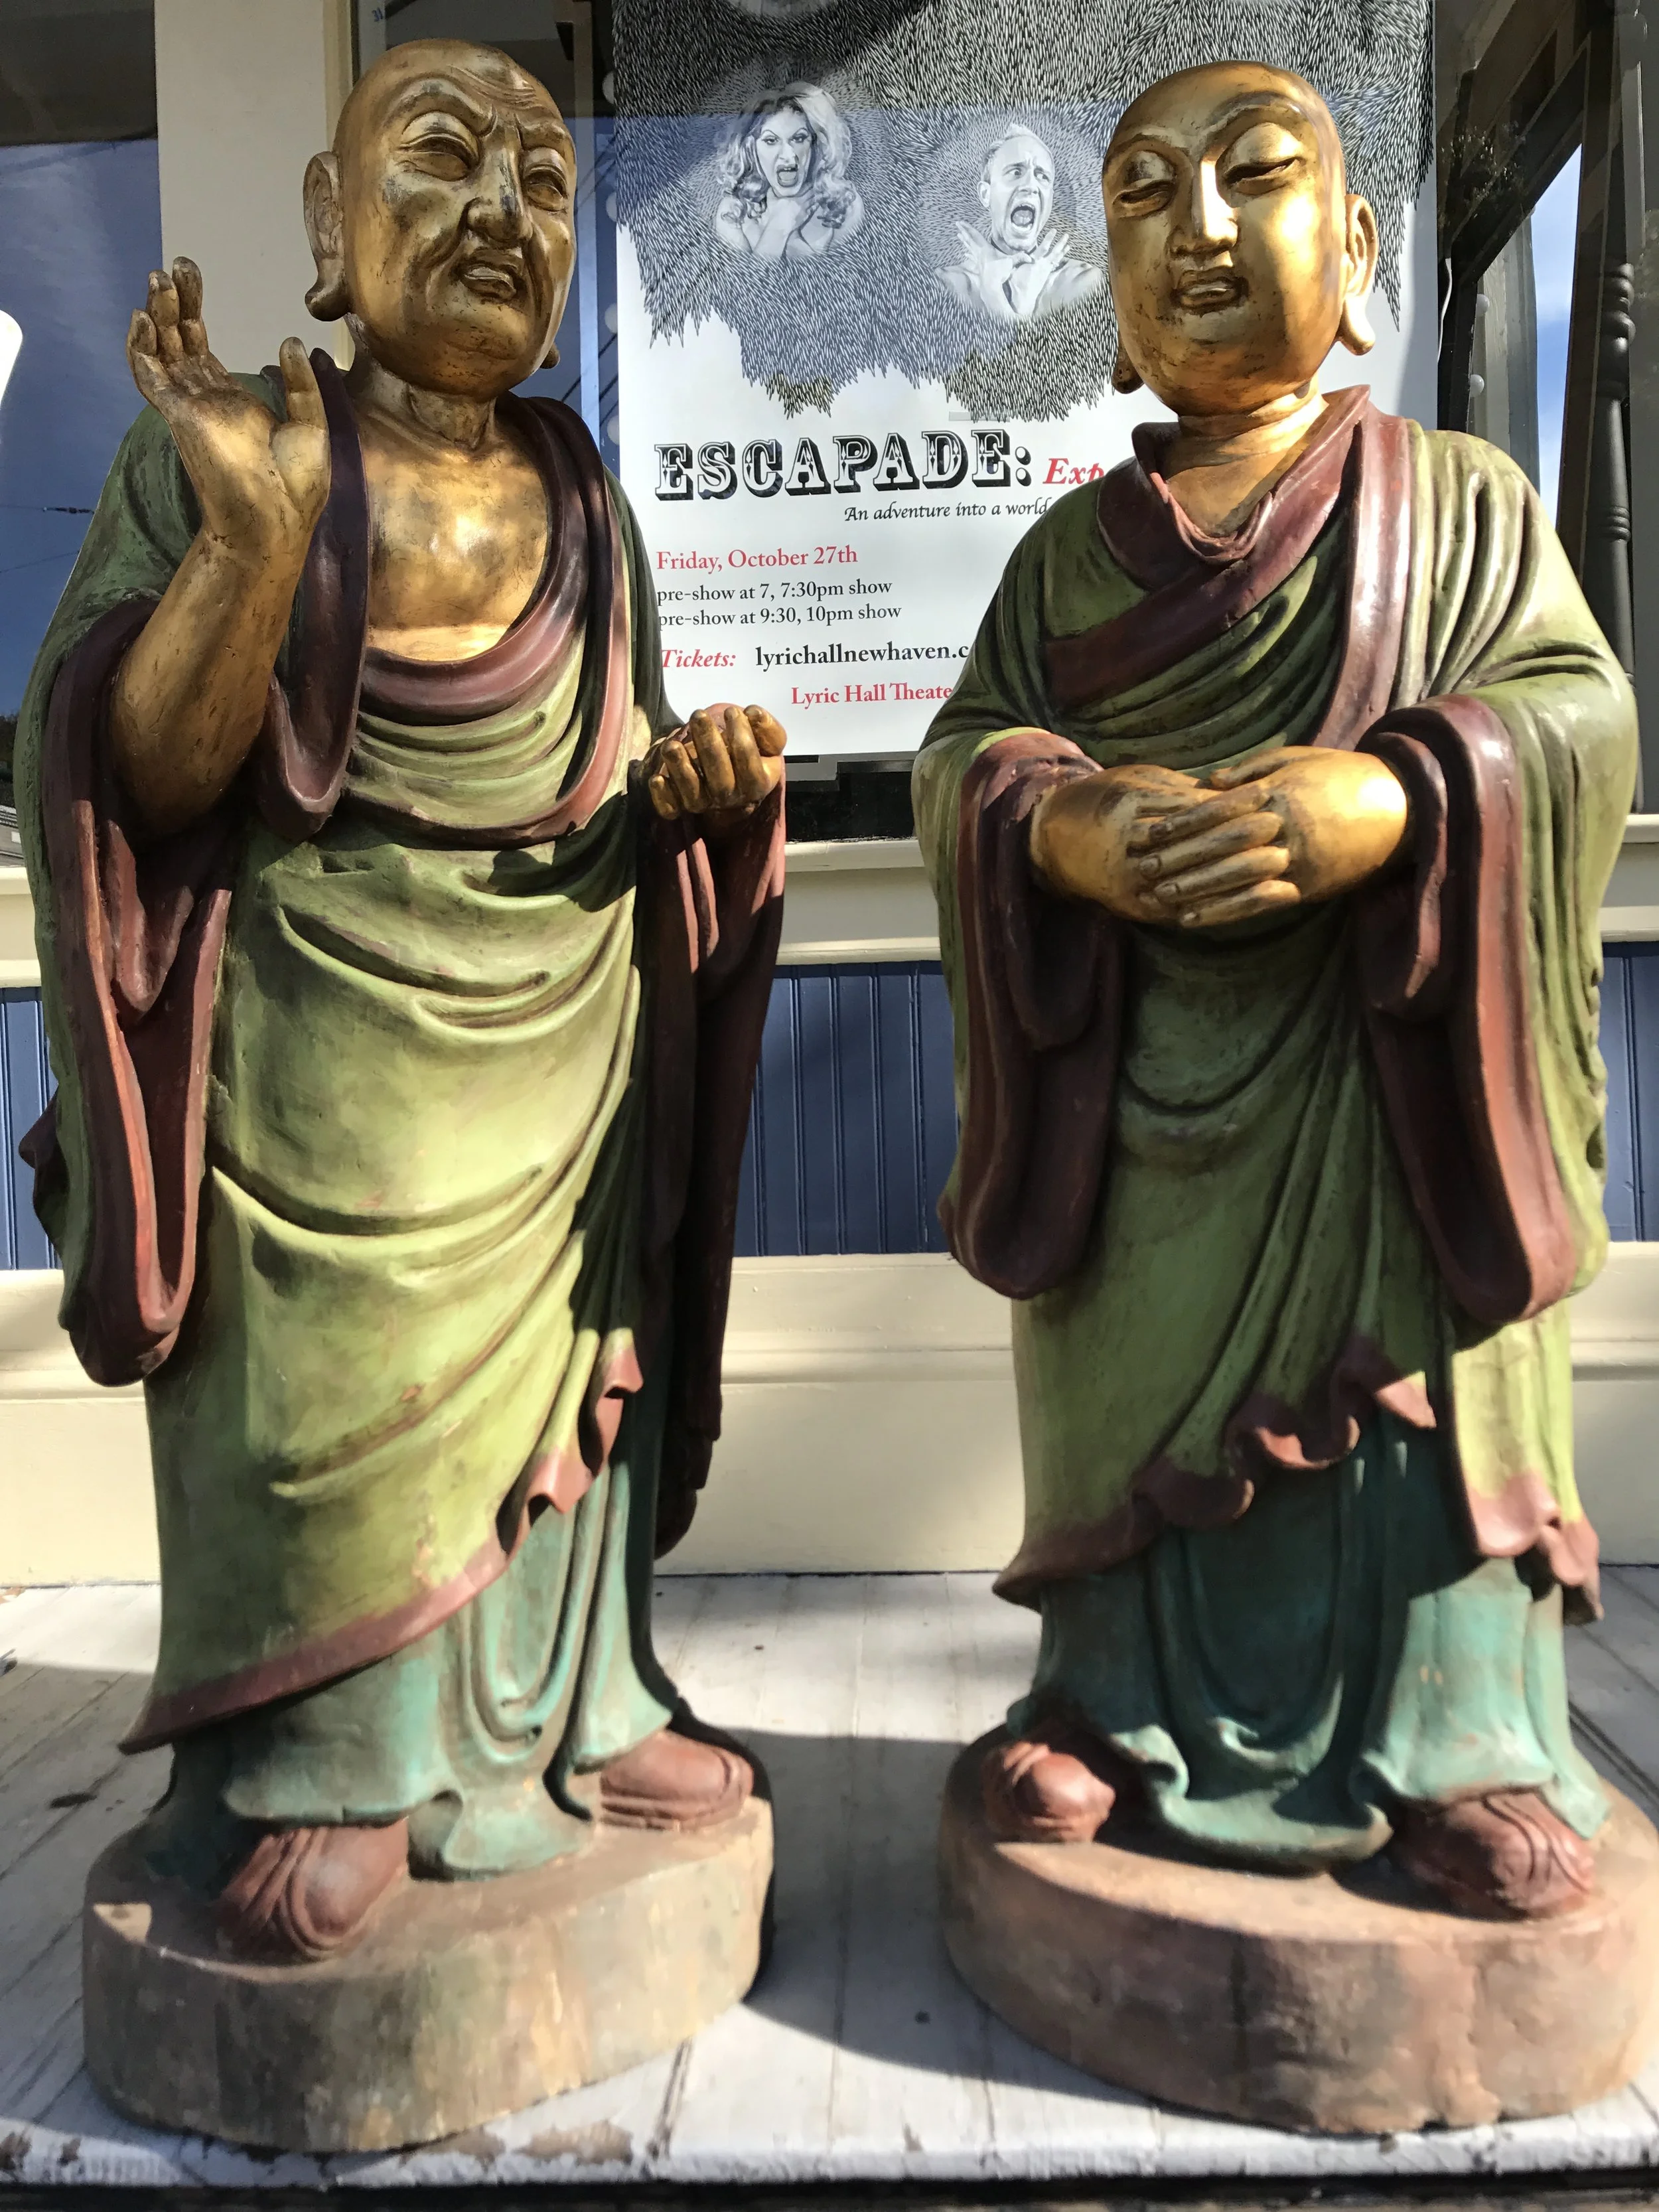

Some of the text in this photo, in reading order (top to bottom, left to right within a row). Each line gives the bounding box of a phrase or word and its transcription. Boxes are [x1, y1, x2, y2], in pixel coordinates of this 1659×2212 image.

[654, 429, 1032, 500] ESCAPADE:
[844, 496, 1052, 522] An adventure into a world
[656, 544, 859, 575] Friday, October 27th
[657, 578, 893, 606] pre-show at 7, 7:30pm show
[658, 603, 902, 631] pre-show at 9:30, 10pm show
[662, 648, 737, 668] Tickets:
[791, 687, 840, 709] Lyric
[844, 684, 887, 702] Hall
